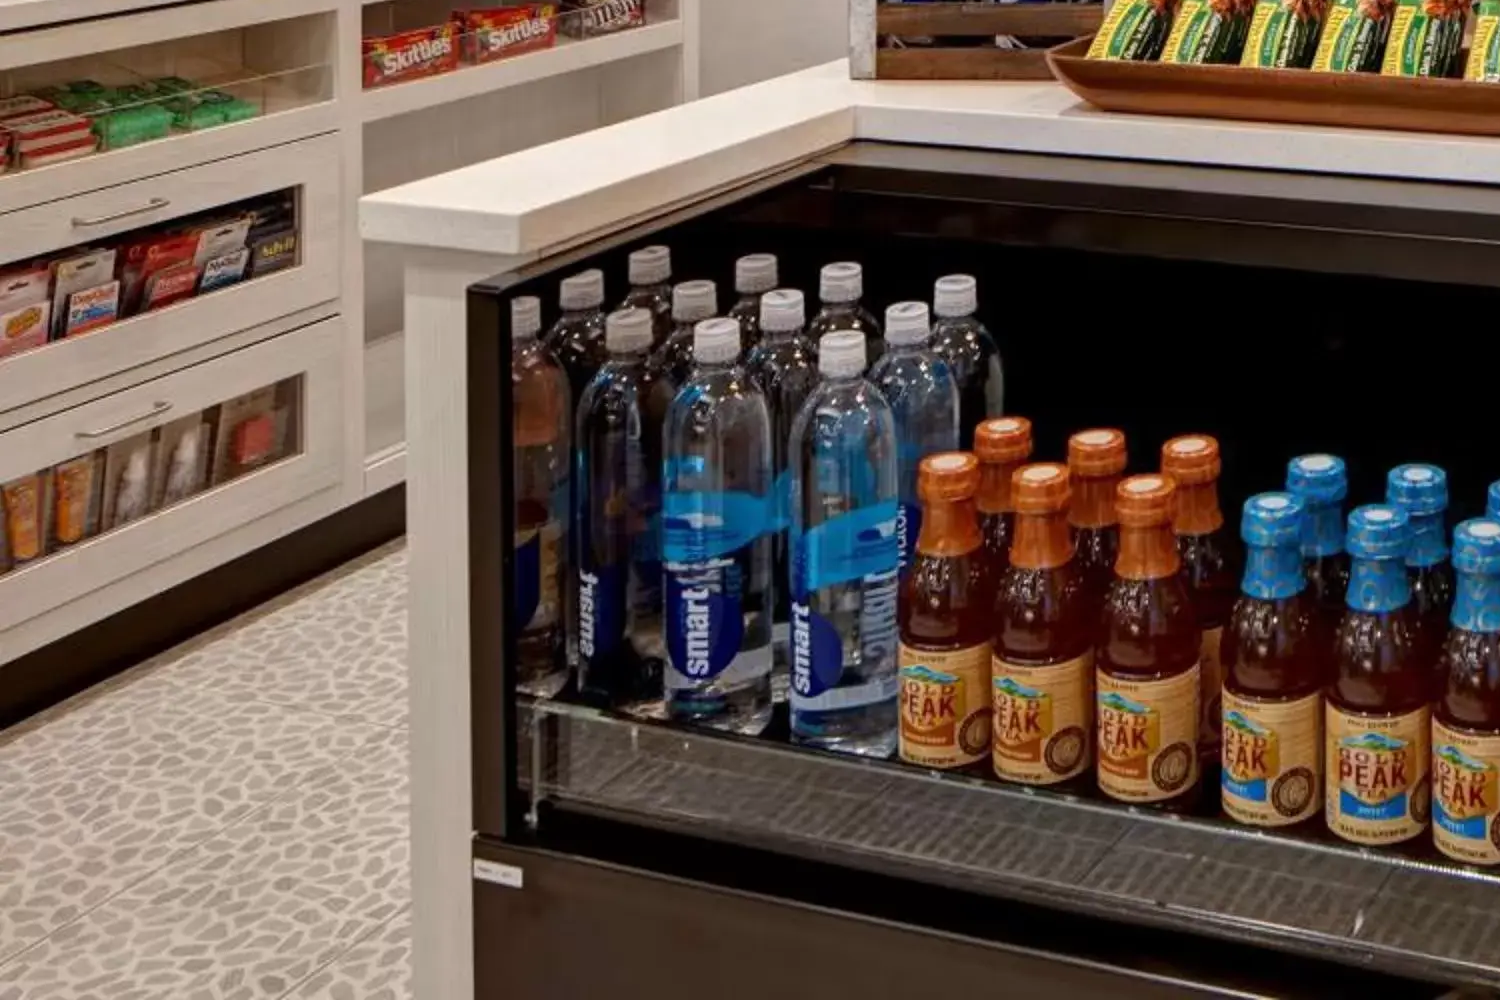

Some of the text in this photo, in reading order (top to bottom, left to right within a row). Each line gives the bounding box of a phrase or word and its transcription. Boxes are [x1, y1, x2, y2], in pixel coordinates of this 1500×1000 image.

[487, 16, 551, 51] Skittles
[382, 36, 452, 76] Skittles
[681, 587, 709, 675] smart
[791, 600, 811, 695] smart
[1225, 740, 1267, 774] EAK
[1340, 748, 1407, 765] GOLD
[1339, 760, 1407, 789] PEAK
